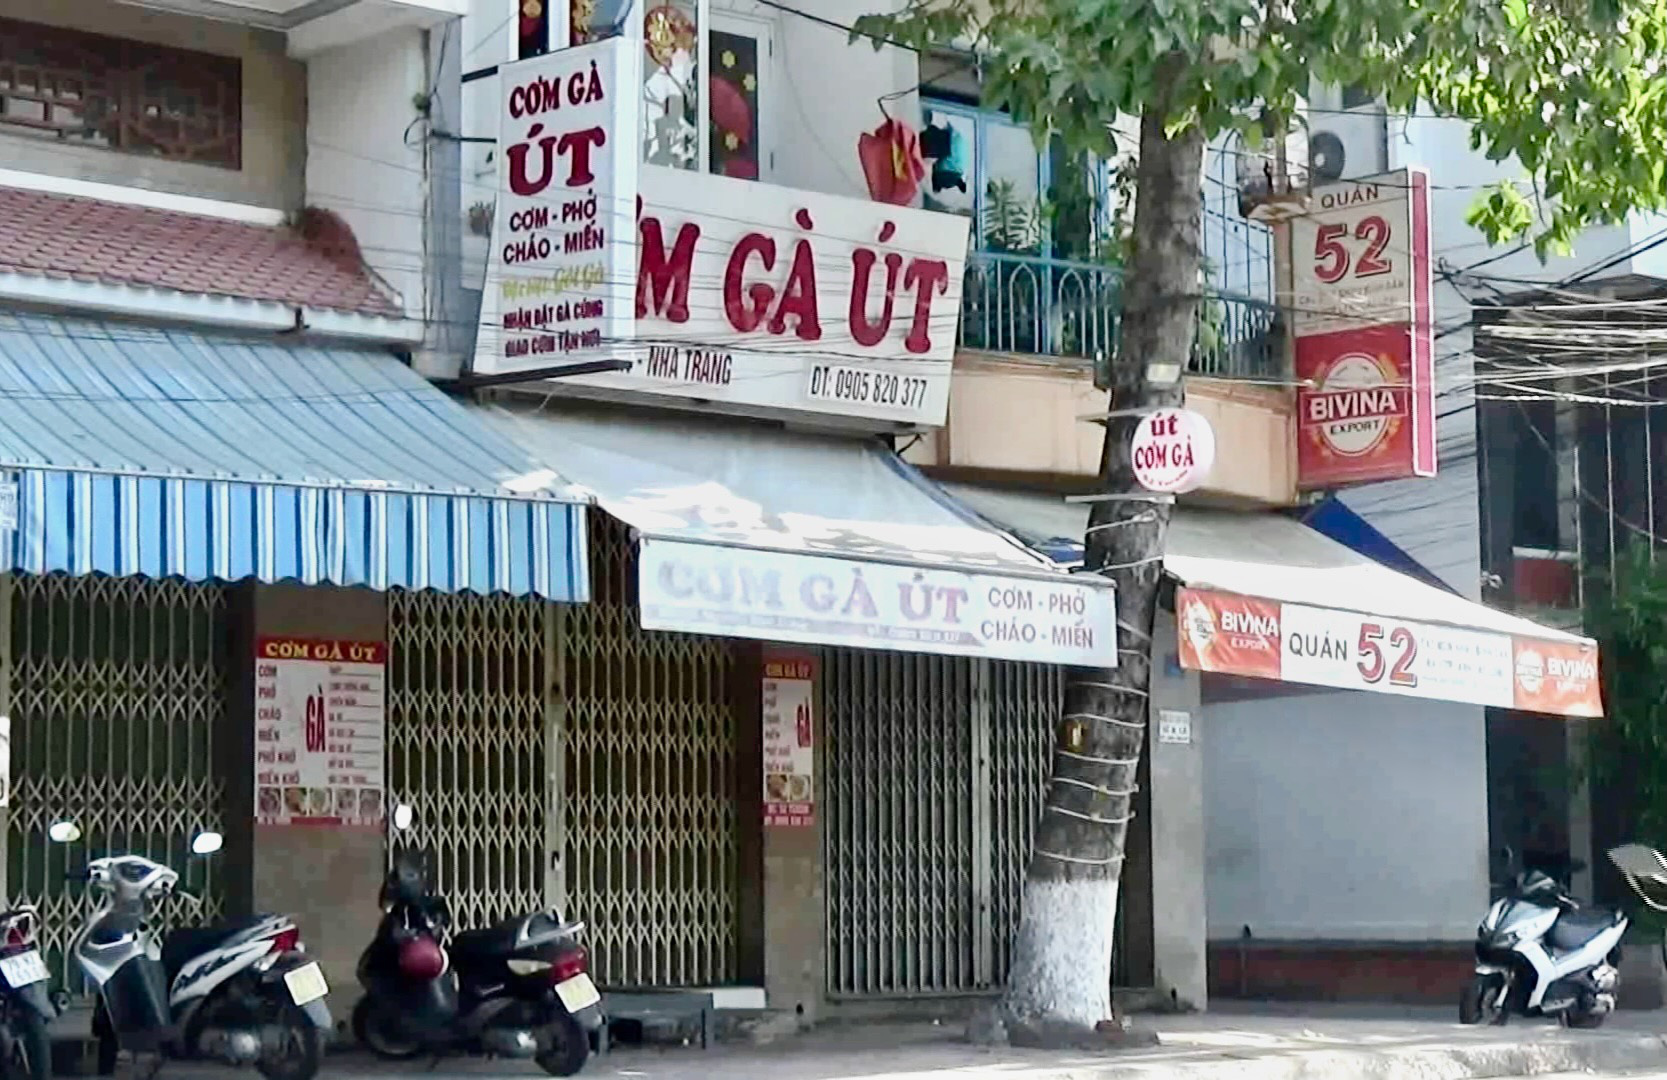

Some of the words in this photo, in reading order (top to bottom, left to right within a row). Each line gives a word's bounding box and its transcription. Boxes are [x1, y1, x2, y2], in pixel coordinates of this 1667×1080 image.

[509, 74, 560, 118] CƠM
[567, 59, 604, 105] GÀ
[506, 123, 606, 195] ÚT
[509, 205, 548, 232] CƠM
[562, 188, 597, 223] PHỞ
[1321, 182, 1379, 209] QUÁN
[503, 232, 550, 264] CHÁO
[1314, 215, 1392, 283] 52
[723, 208, 822, 341] GÀ
[849, 221, 948, 354] ÚT
[646, 345, 679, 379] NHA
[684, 348, 733, 385] TRANG
[835, 368, 869, 401] 0905
[872, 373, 899, 404] 820
[901, 376, 927, 408] 377
[1310, 389, 1397, 420] BIVINA
[1330, 418, 1381, 435] EXPORT
[1171, 434, 1194, 468] GÀ
[988, 585, 1033, 611] CƠM
[1049, 587, 1086, 615] PHỞ
[981, 616, 1036, 643] CHÁO
[1221, 609, 1279, 637] BIVINA
[265, 639, 308, 658] CƠM
[1289, 628, 1348, 662] QUÁN
[1356, 621, 1418, 688] 52
[306, 684, 326, 753] GÀ
